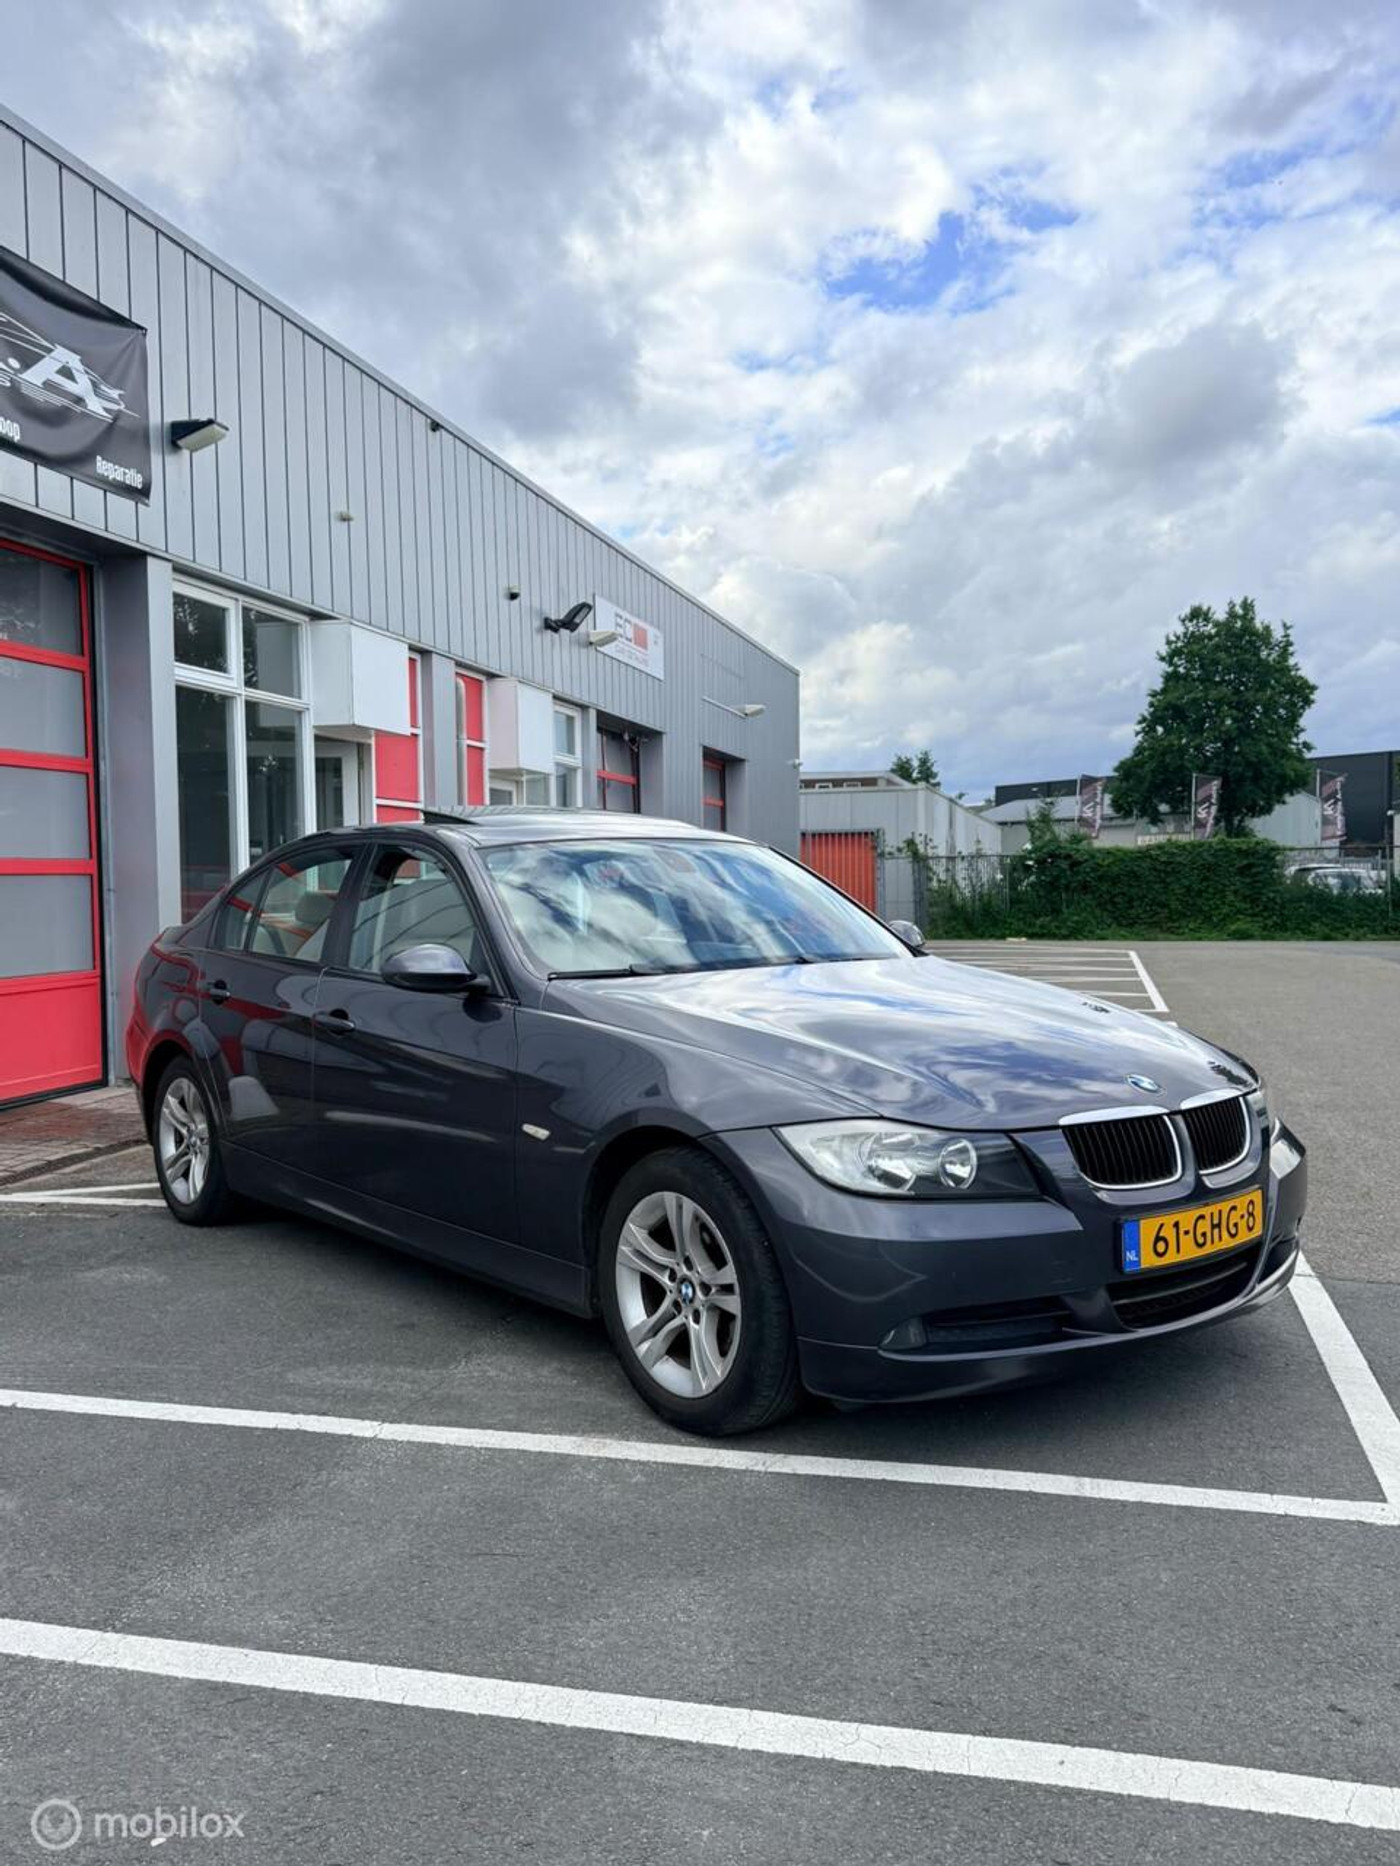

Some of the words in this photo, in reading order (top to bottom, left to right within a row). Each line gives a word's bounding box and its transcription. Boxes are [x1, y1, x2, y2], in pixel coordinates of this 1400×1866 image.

[96, 455, 143, 489] Reparatie
[1152, 1199, 1256, 1258] 61-GHG-8
[1125, 1249, 1139, 1262] NL
